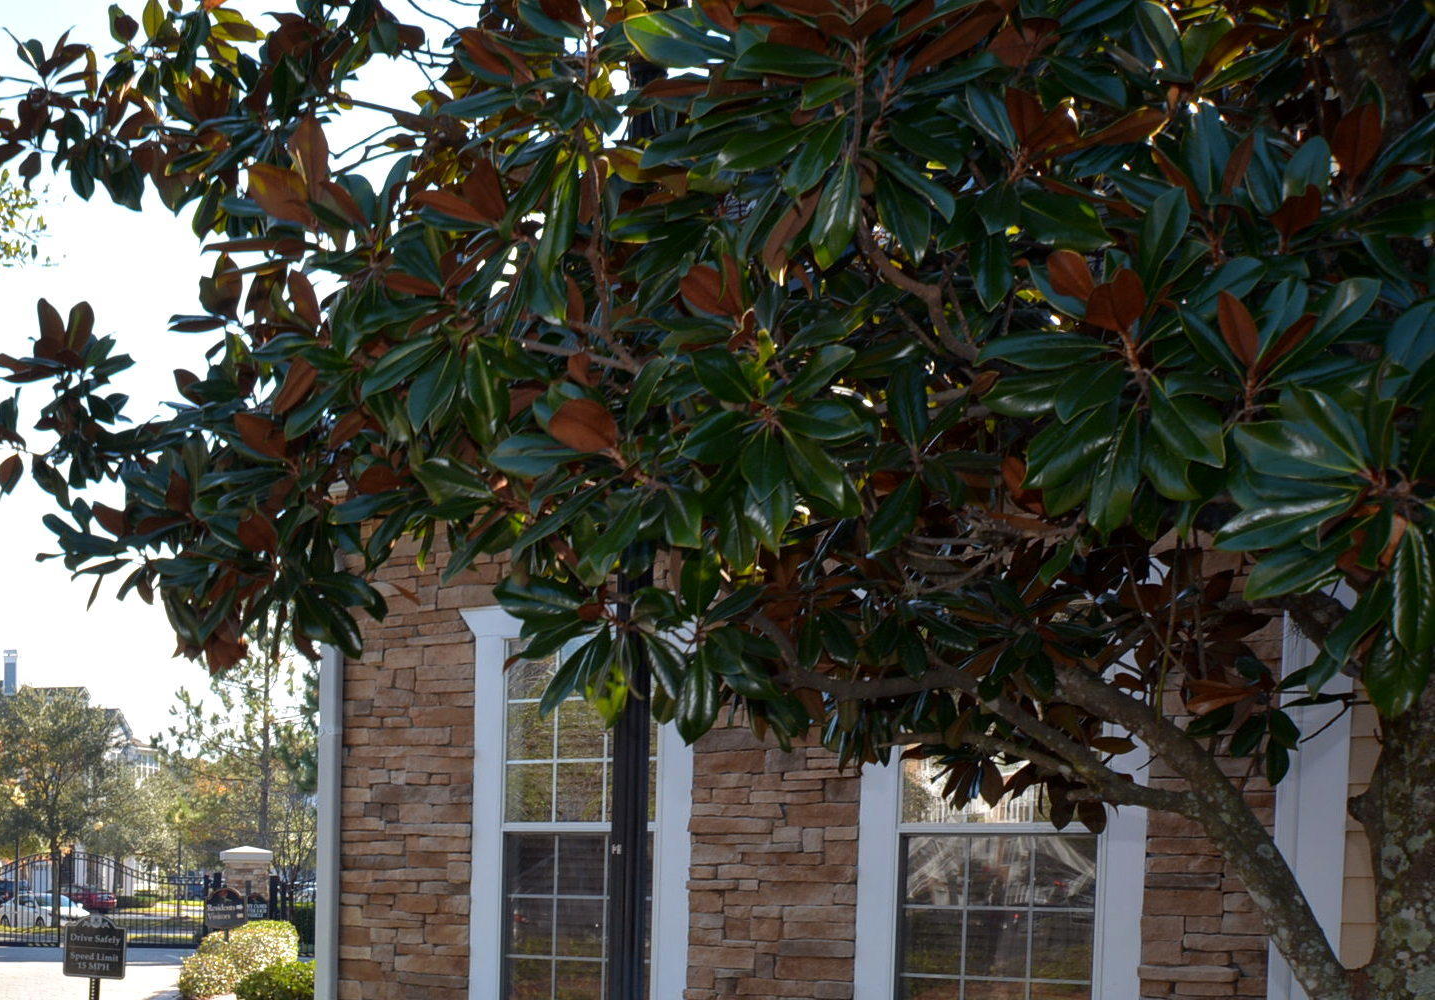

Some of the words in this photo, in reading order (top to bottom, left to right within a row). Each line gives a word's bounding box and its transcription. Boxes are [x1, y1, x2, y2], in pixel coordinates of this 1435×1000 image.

[70, 933, 94, 942] Drive
[95, 934, 121, 945] Safely
[70, 951, 95, 961] Speed
[96, 952, 119, 962] Limit
[88, 962, 110, 971] MPH
